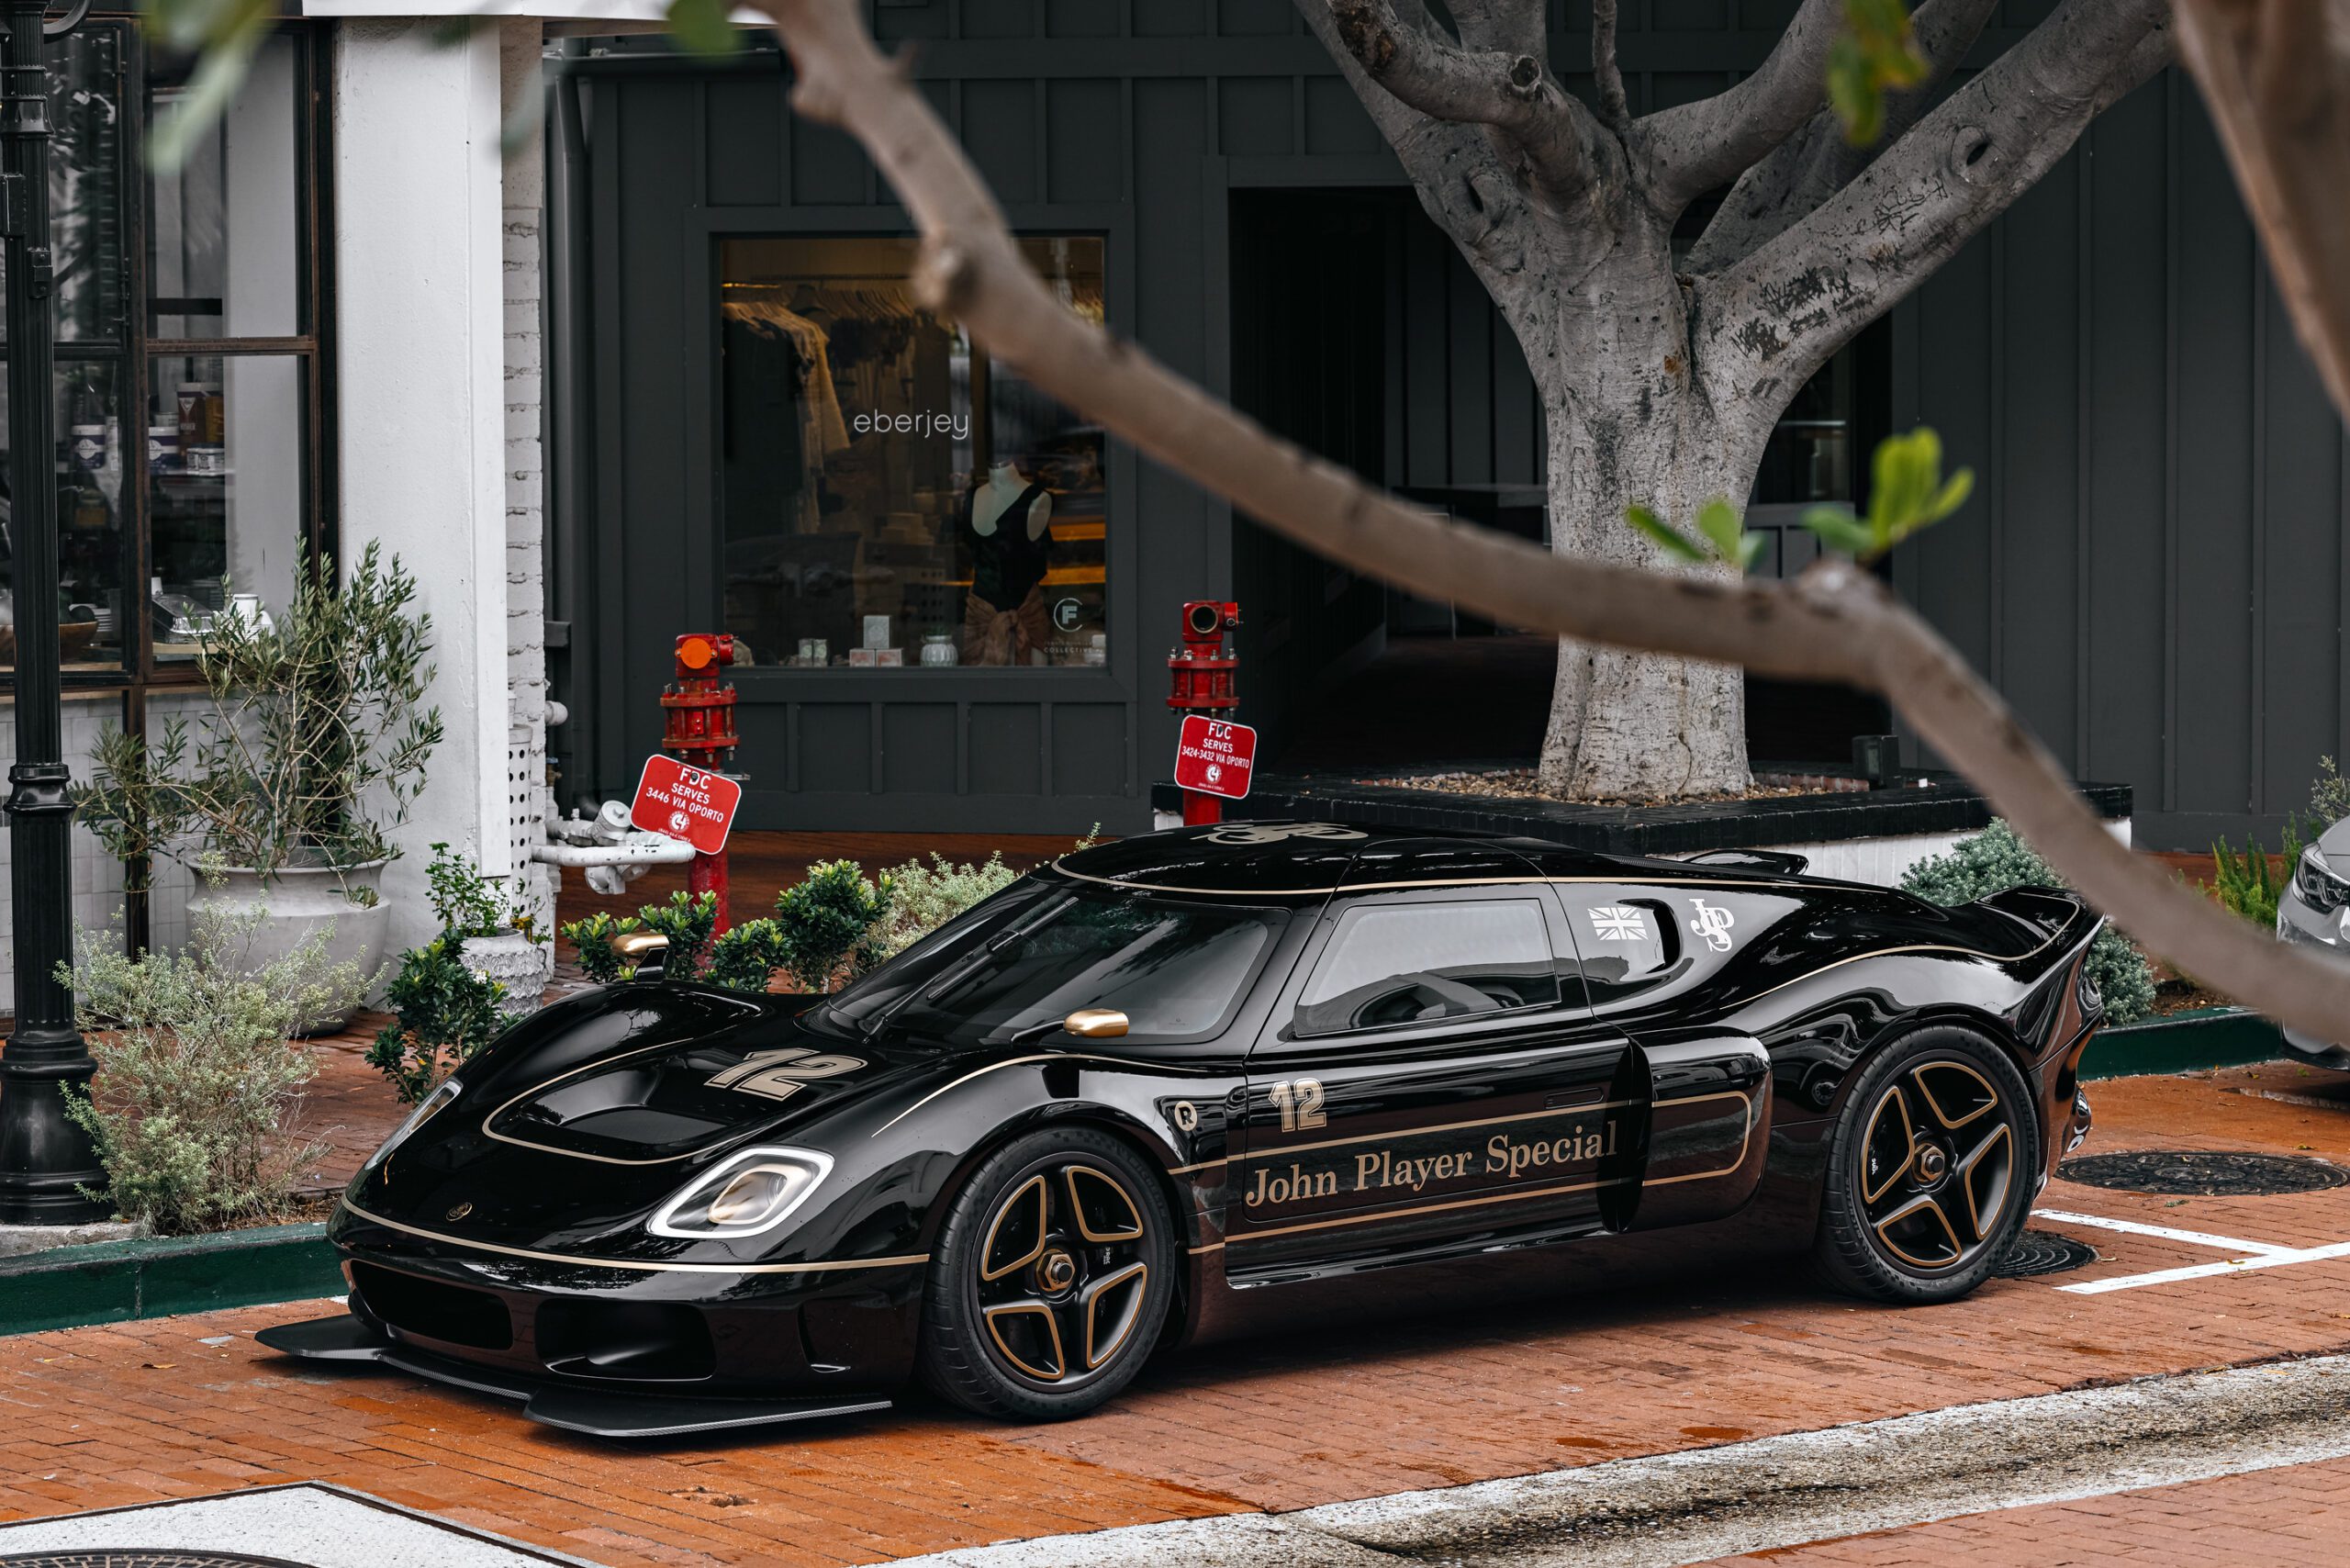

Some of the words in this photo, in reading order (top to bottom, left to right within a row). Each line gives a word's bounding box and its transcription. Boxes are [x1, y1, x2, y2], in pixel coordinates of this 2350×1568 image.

[854, 409, 968, 441] eberjey
[1208, 722, 1232, 740] FDC
[1181, 745, 1214, 761] 3424-3432
[1215, 753, 1225, 764] VIA
[1226, 756, 1249, 769] OPORTO
[1203, 738, 1234, 753] SERVES
[679, 767, 711, 790] FDC
[646, 787, 669, 803] 3446
[672, 796, 687, 810] VIA
[688, 802, 724, 823] OPORTO
[671, 783, 711, 804] SERVES
[703, 1047, 868, 1102] 12
[1180, 1106, 1194, 1126] R
[1268, 1077, 1327, 1133] 12
[1245, 1164, 1338, 1207] John
[1353, 1150, 1473, 1192] Player
[1485, 1120, 1618, 1179] Special
